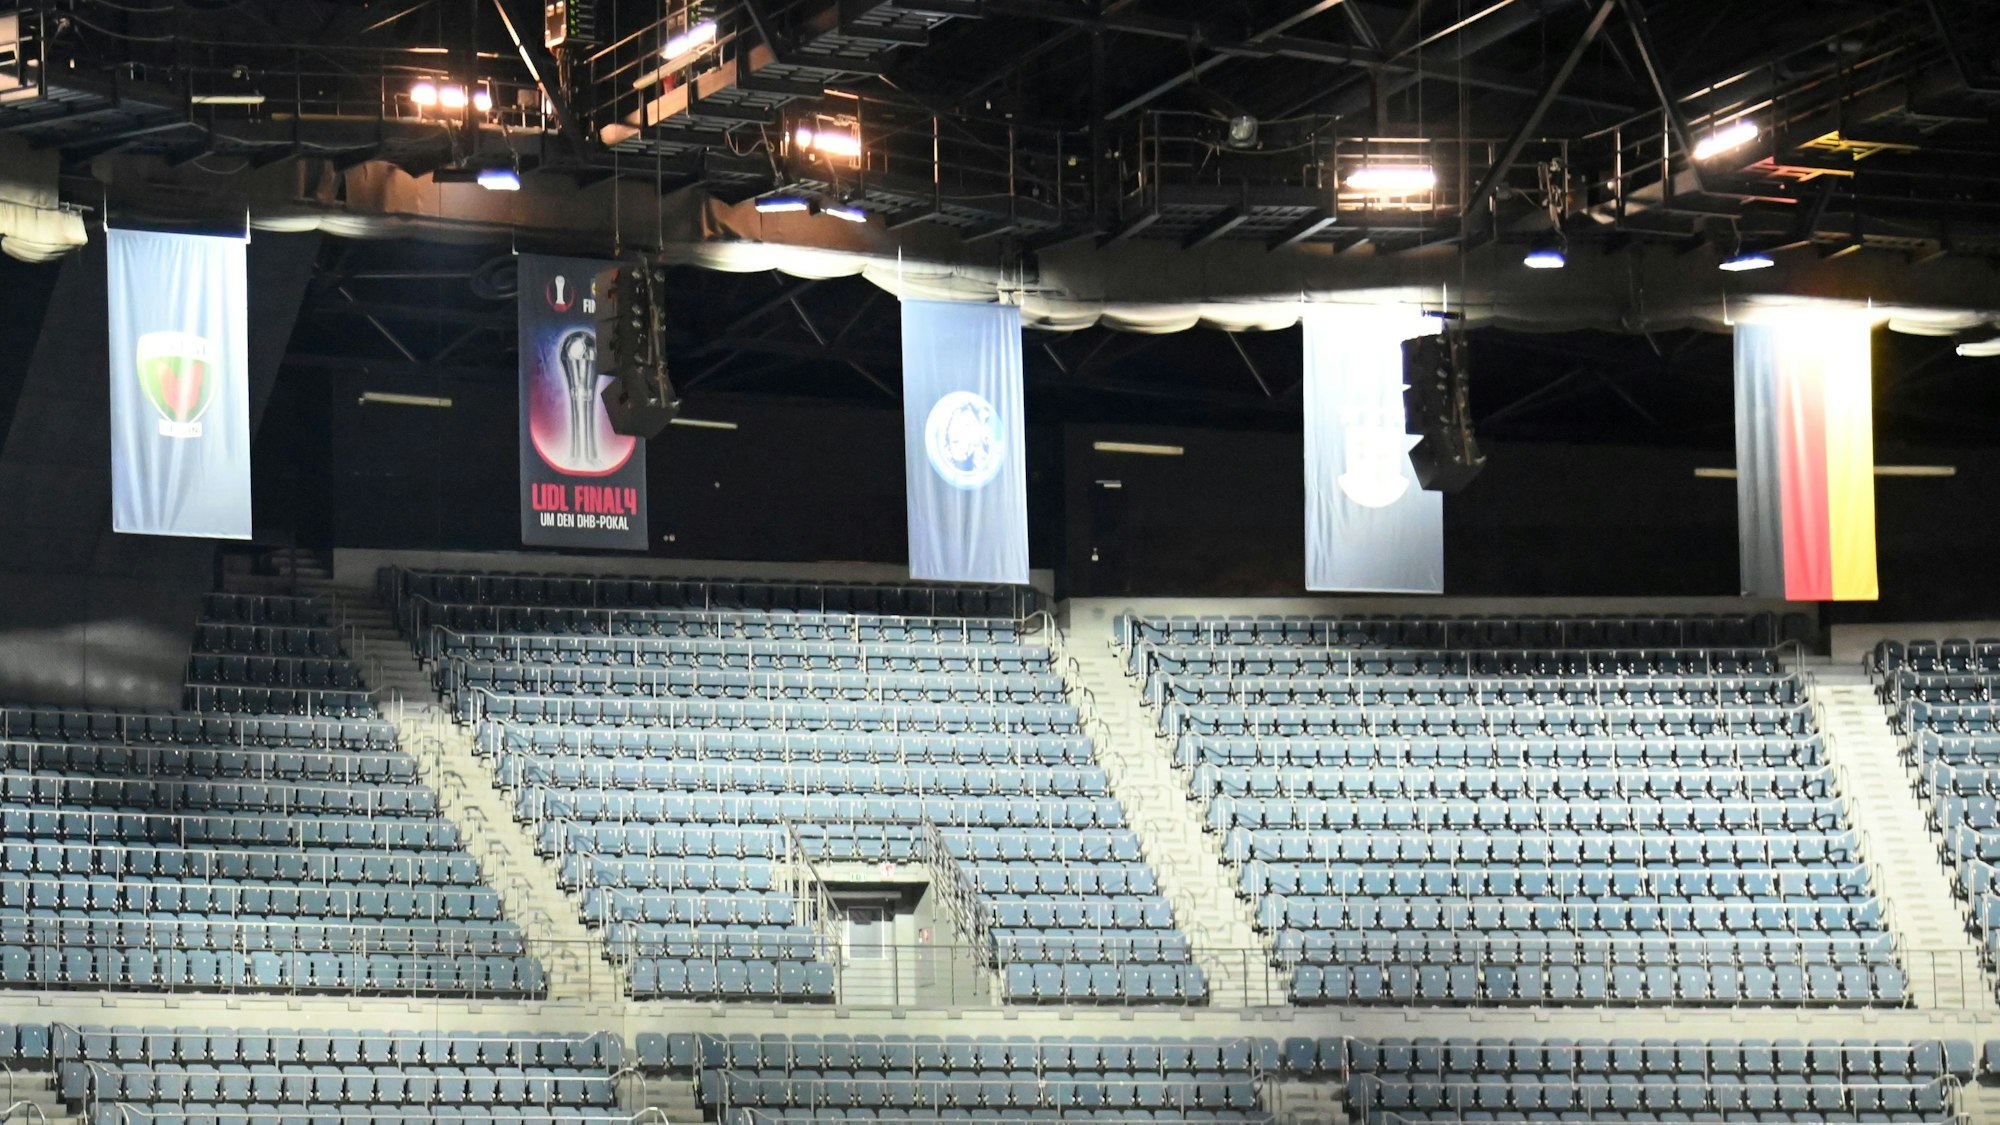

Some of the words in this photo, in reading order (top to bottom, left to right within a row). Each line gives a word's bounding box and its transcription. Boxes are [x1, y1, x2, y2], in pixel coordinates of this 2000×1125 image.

[532, 483, 569, 511] LIDL
[574, 485, 637, 515] FINAL4
[540, 512, 554, 526] UM
[557, 513, 574, 527] DEN
[577, 514, 629, 530] DHB-POKAL
